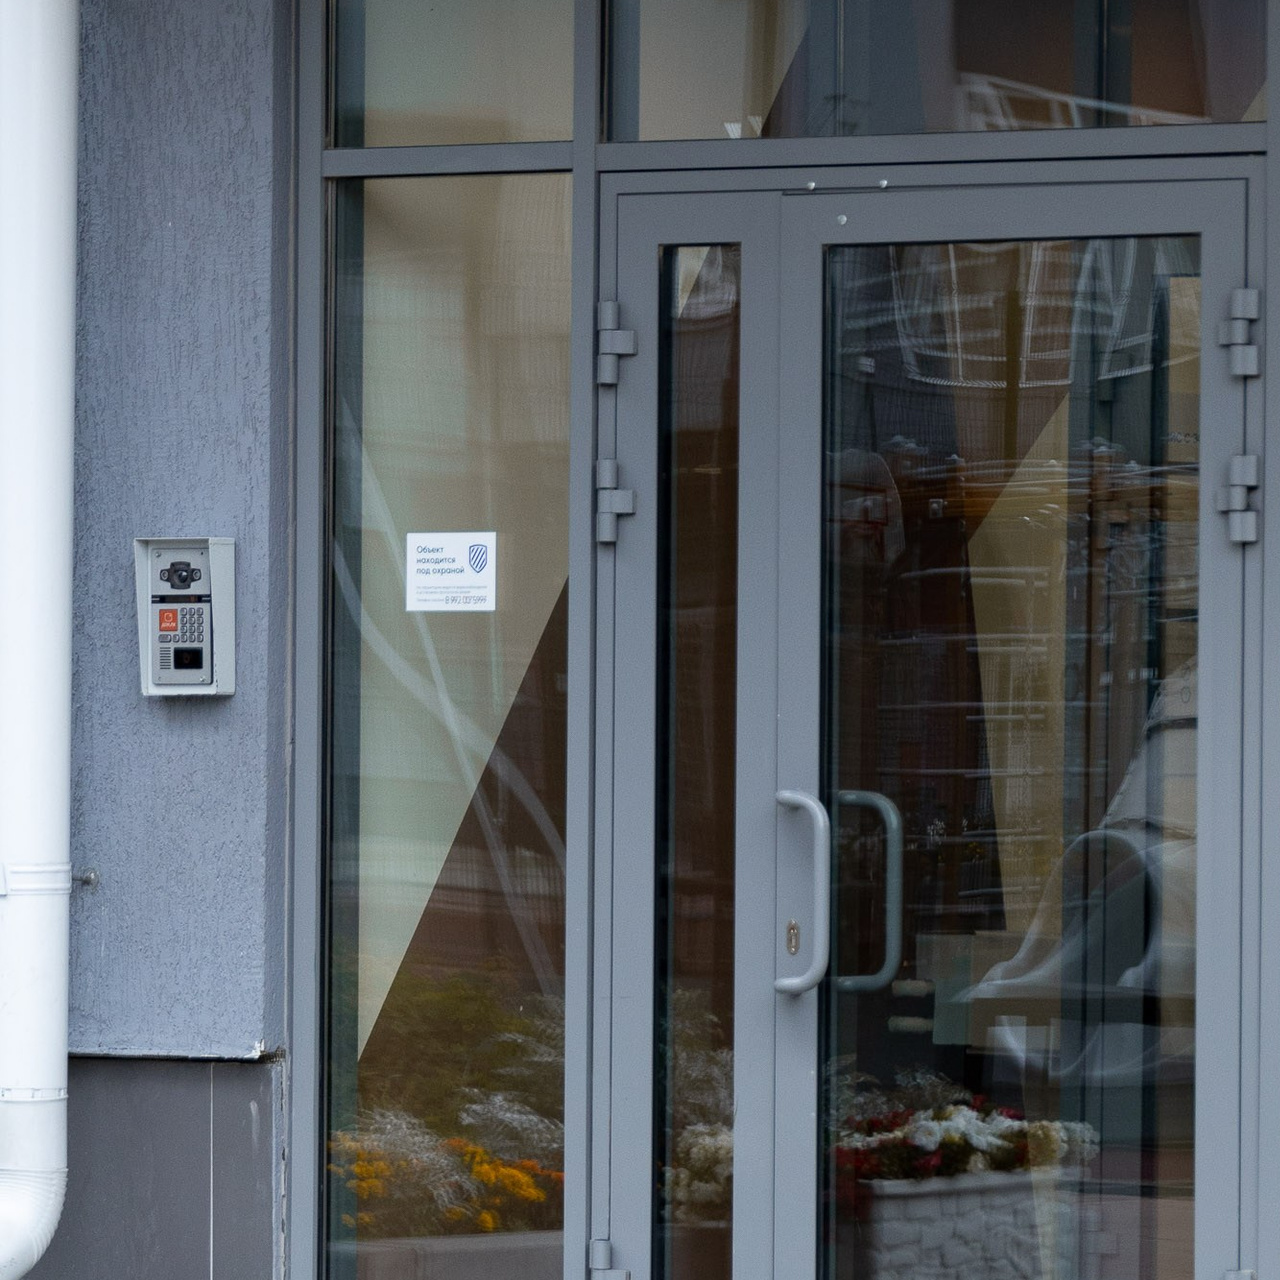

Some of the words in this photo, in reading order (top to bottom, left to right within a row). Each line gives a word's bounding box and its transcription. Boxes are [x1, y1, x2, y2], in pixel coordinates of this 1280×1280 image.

[416, 545, 444, 554] Объект
[416, 557, 456, 565] находится
[432, 566, 465, 576] охраной
